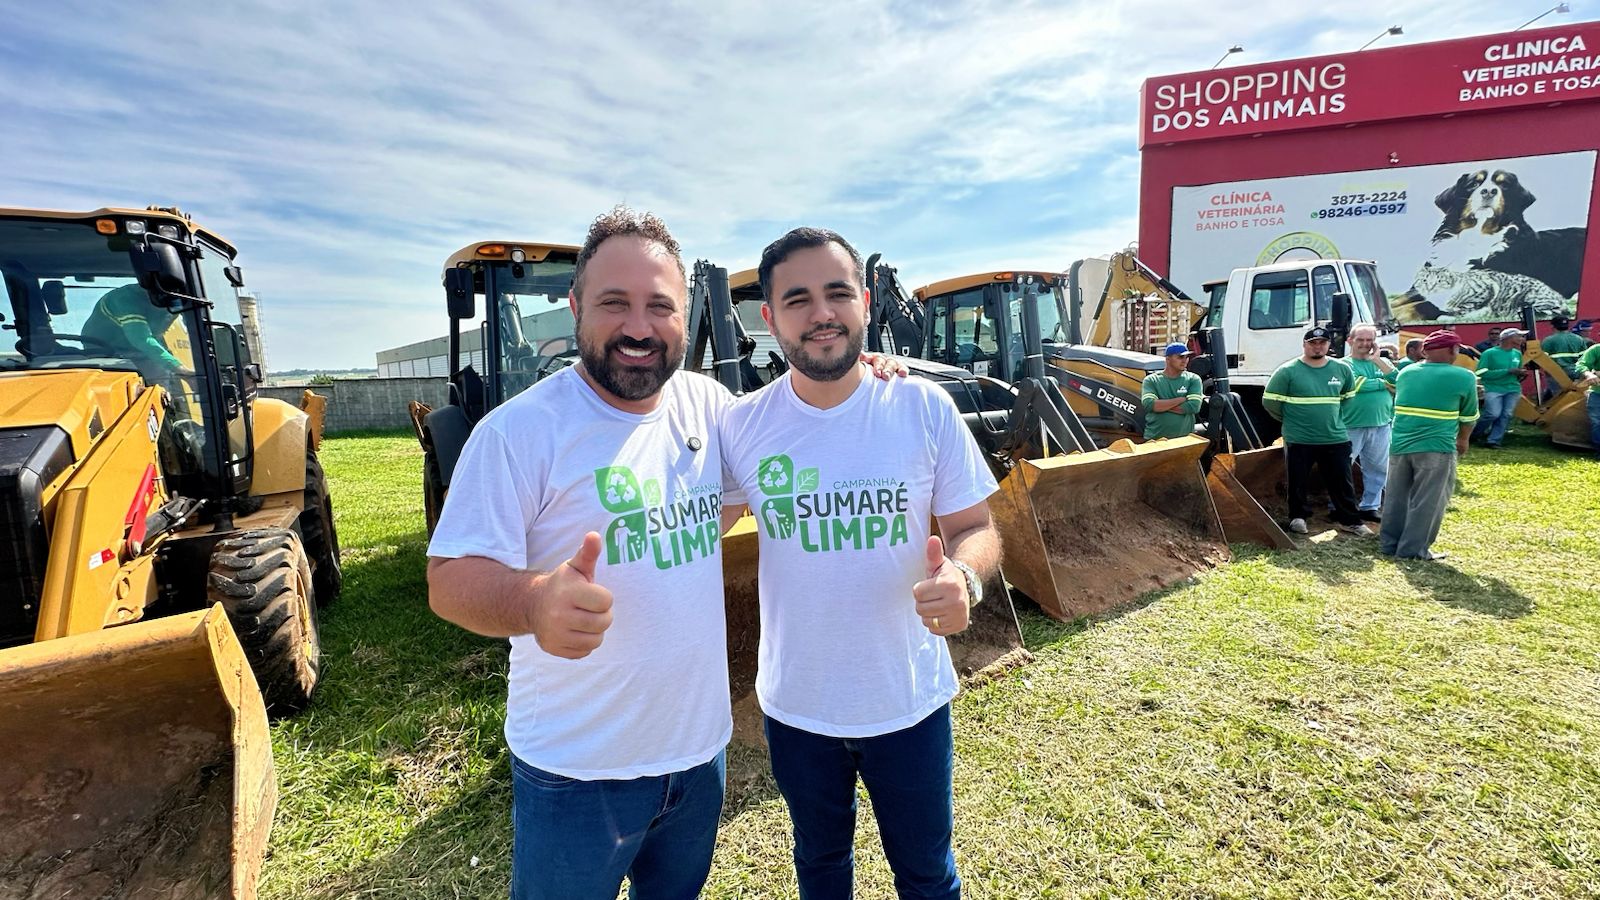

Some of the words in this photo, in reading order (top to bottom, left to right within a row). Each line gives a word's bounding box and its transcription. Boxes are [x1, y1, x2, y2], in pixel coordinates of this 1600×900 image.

[1485, 35, 1586, 61] CLINICA
[1462, 55, 1600, 83] VETERINÁRIA
[1154, 63, 1346, 110] SHOPPING
[1459, 82, 1528, 101] BANHO
[1534, 81, 1546, 94] E
[1552, 75, 1600, 91] TOSA
[1153, 109, 1210, 133] DOS
[1219, 93, 1346, 126] ANIMAIS
[1198, 204, 1285, 219] VETERINÁRIA
[1211, 191, 1272, 206] CLÍNICA
[1319, 203, 1405, 219] 98246-0597
[1331, 191, 1407, 206] 3873-2224
[1196, 220, 1238, 231] BANHO
[1242, 219, 1249, 228] E
[1252, 217, 1284, 227] TOSA
[1097, 388, 1137, 415] DEERE
[833, 477, 897, 490] CAMPANHA
[796, 482, 908, 518] SUMARÉ
[651, 520, 719, 570] LIMP
[799, 514, 908, 552] LIMPA
